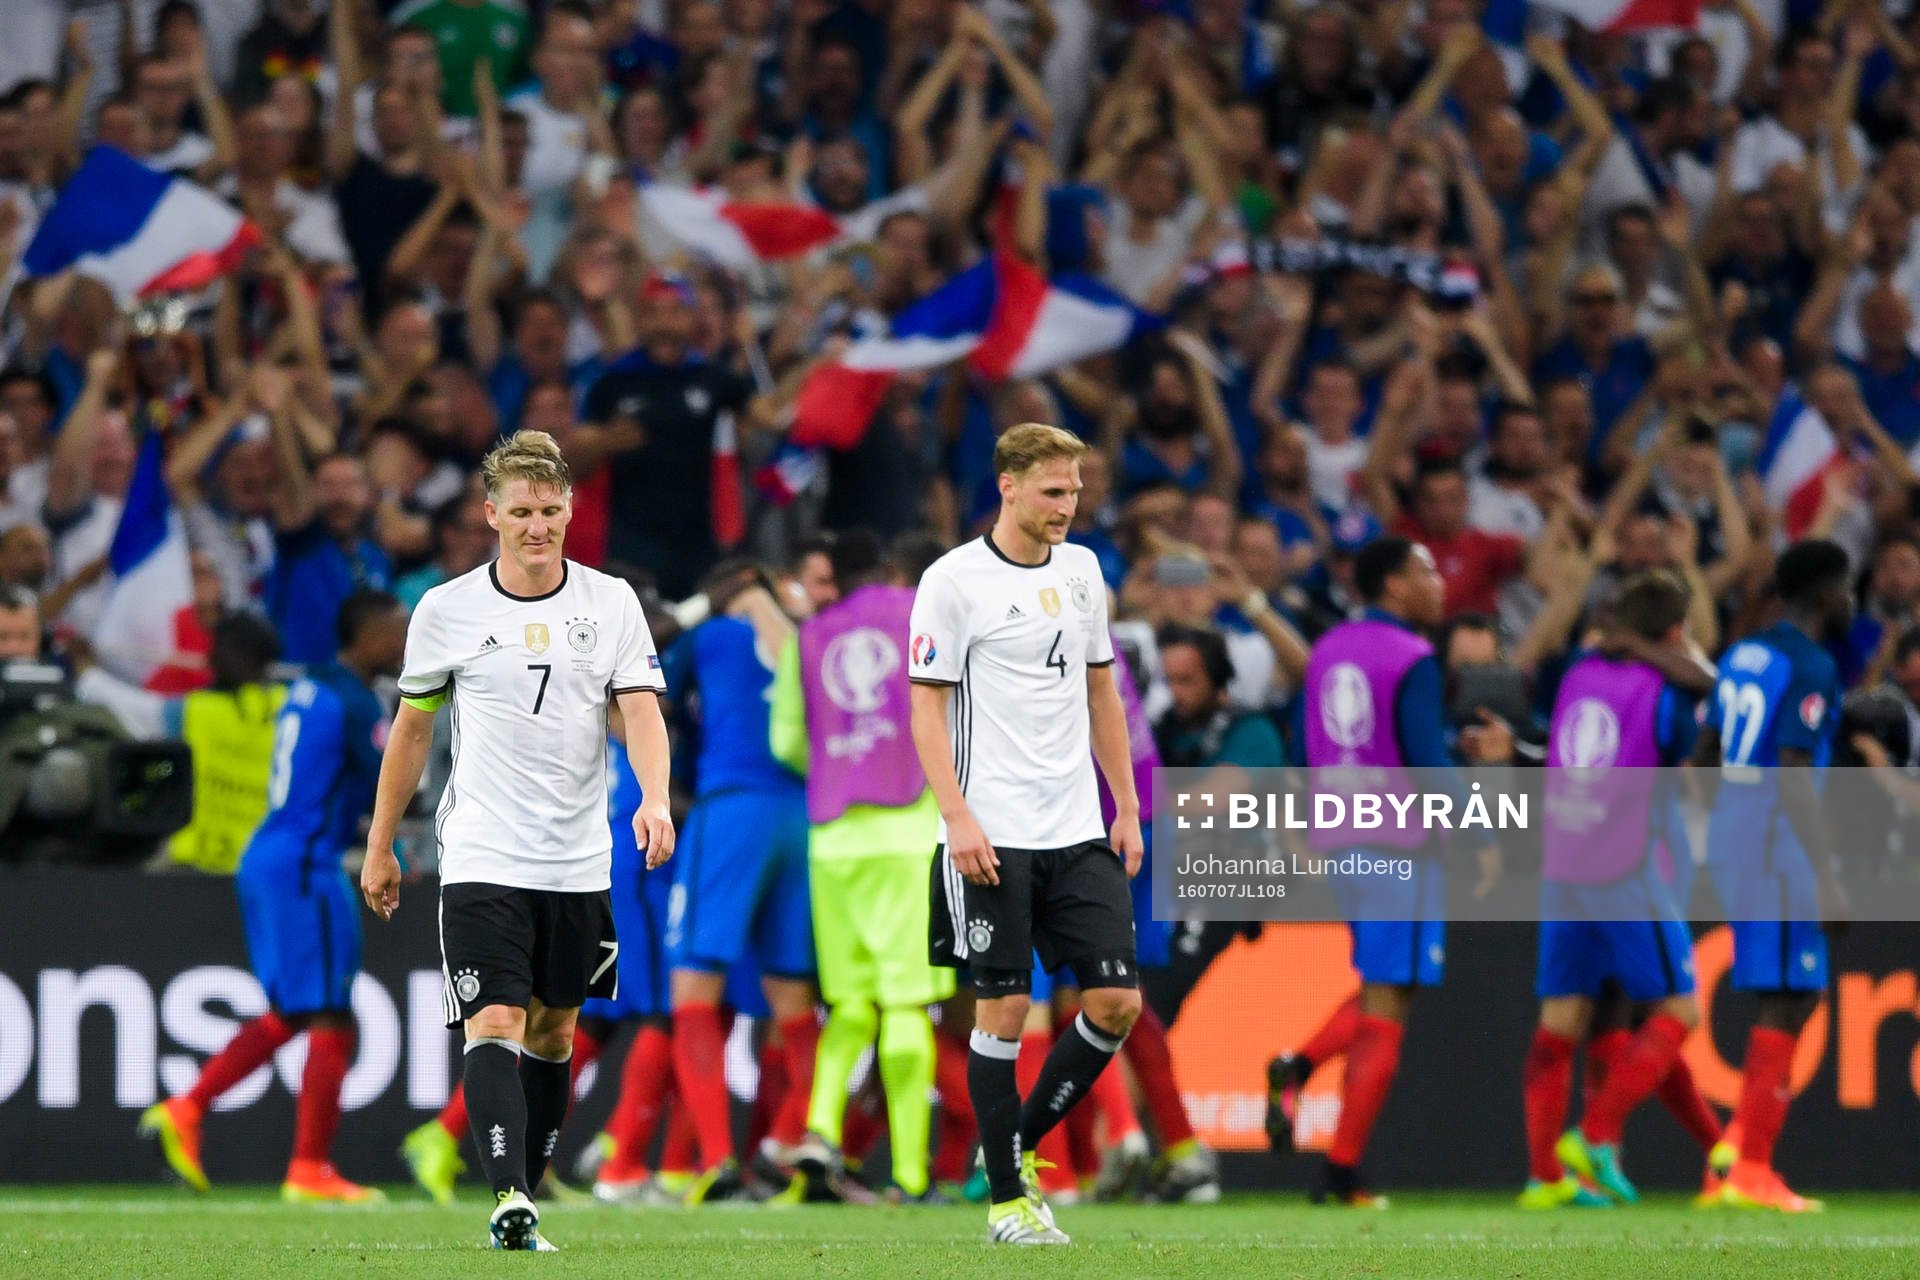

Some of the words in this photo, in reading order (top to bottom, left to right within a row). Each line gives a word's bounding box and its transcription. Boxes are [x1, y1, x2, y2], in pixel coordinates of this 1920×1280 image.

[1046, 630, 1068, 678] 4
[527, 664, 552, 715] 7
[589, 940, 619, 985] 7
[0, 964, 453, 1112] nsor
